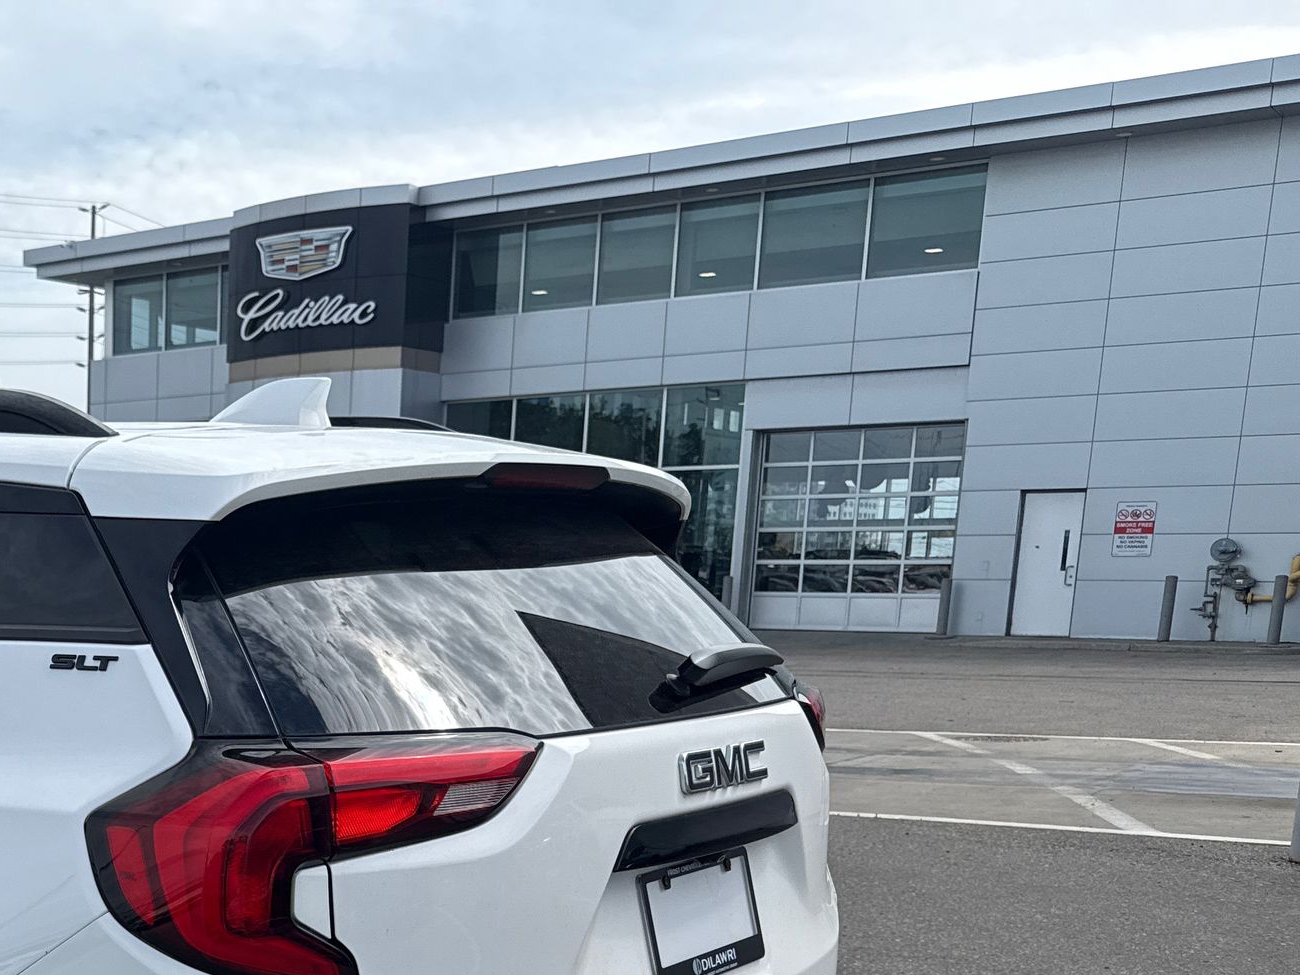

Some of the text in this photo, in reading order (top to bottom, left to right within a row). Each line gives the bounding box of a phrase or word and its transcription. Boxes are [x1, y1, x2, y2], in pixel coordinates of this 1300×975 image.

[236, 288, 377, 342] Cadillac
[49, 653, 120, 672] SLT
[679, 740, 768, 795] GMC
[701, 947, 737, 971] DILAWRI
